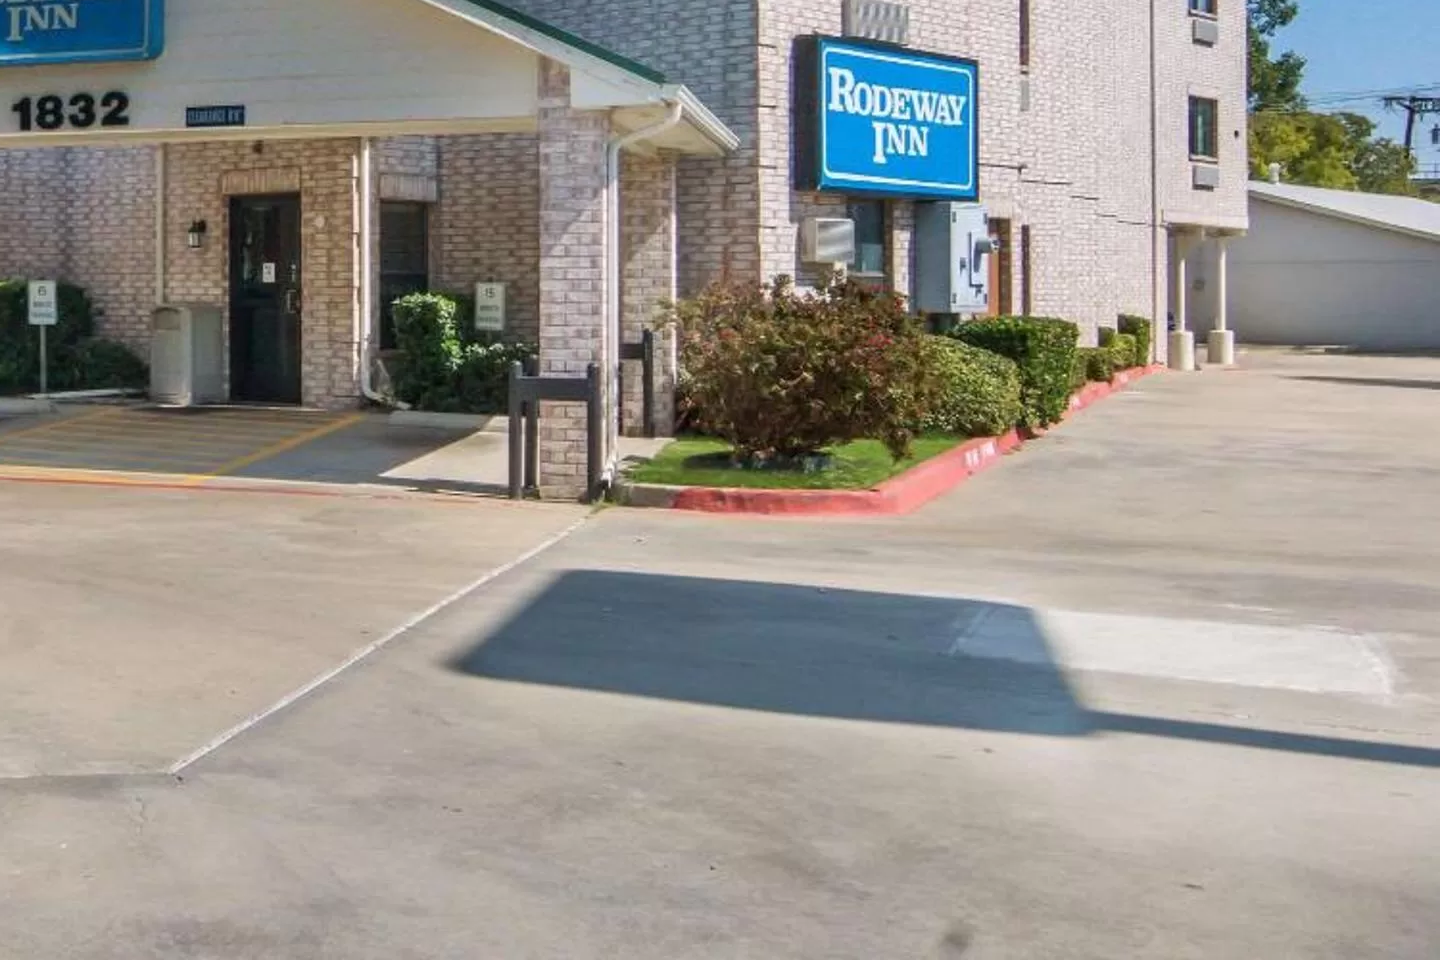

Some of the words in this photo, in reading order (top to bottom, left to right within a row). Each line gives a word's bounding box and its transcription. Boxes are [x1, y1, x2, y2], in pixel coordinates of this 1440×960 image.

[6, 3, 78, 41] INN
[12, 91, 130, 131] 1832
[828, 66, 967, 125] RODEWAY
[872, 120, 929, 164] INN
